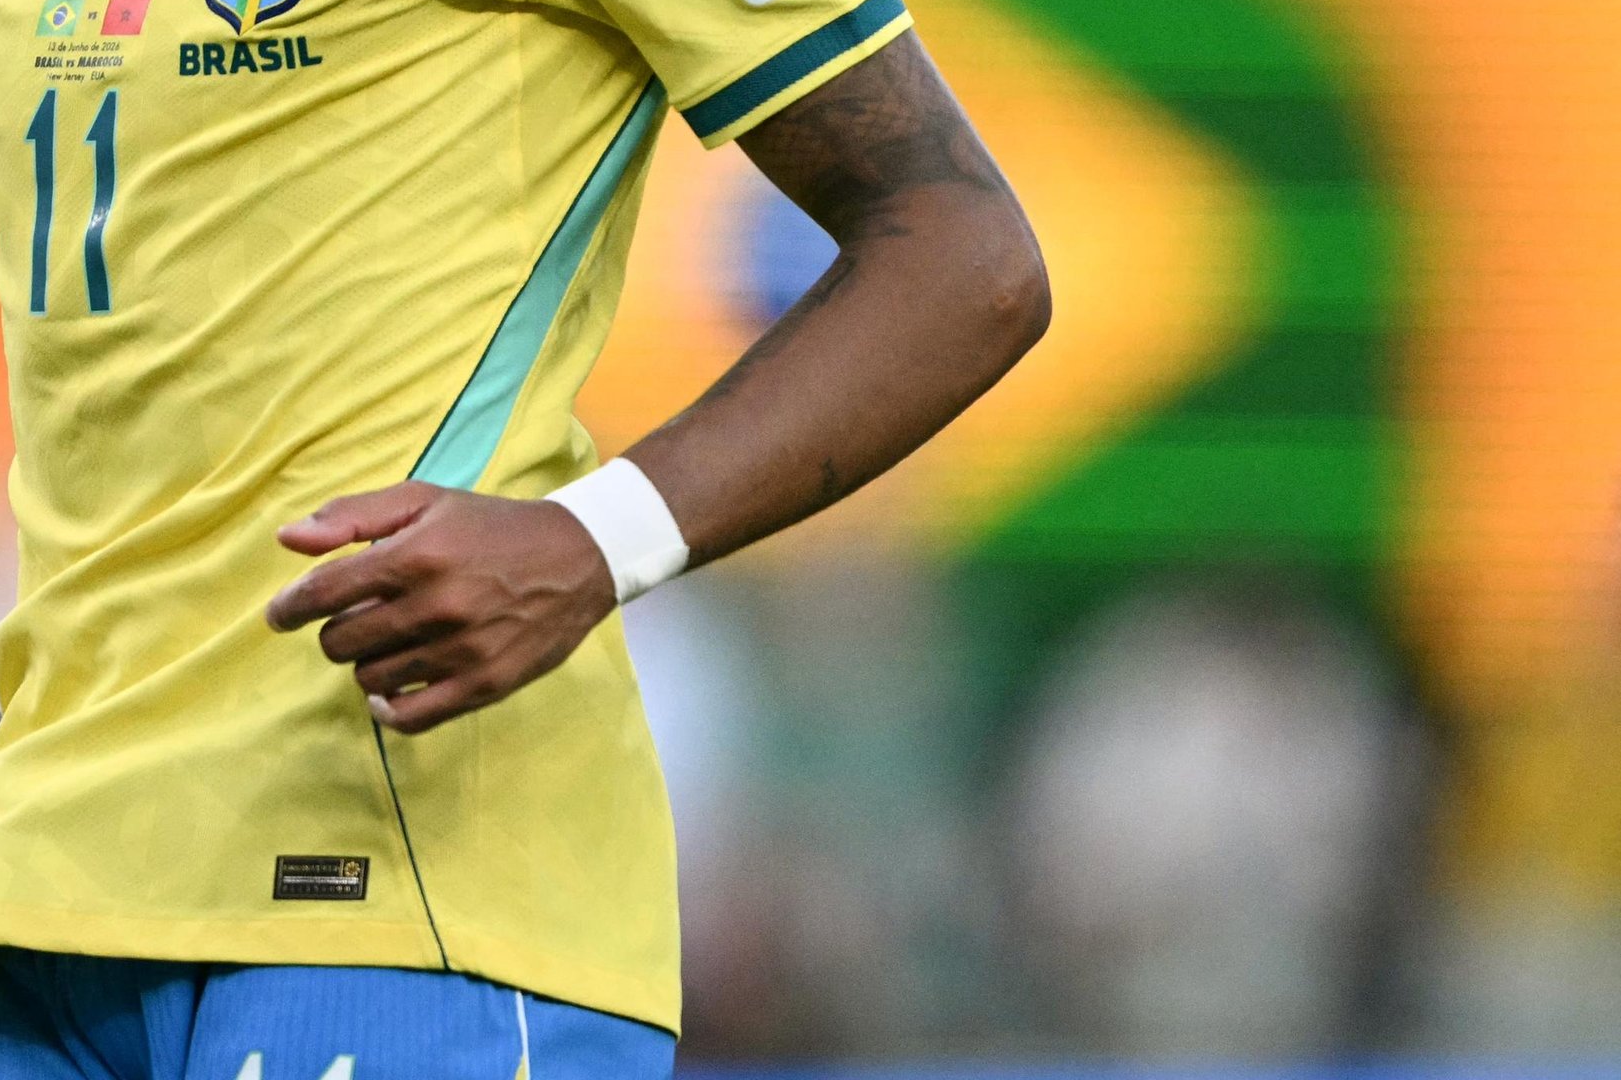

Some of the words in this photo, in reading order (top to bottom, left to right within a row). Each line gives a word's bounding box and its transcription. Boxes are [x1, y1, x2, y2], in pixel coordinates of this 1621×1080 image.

[88, 11, 98, 20] vs
[57, 41, 67, 51] de
[68, 42, 89, 51] Junho
[91, 41, 100, 51] de
[101, 42, 121, 51] 2026
[35, 56, 63, 67] BRASIL
[66, 59, 75, 67] vs
[77, 56, 124, 67] MARROCOS
[179, 36, 323, 76] BRASIL
[64, 72, 85, 82] Jersey
[91, 71, 106, 80] EUA
[24, 88, 118, 316] 11
